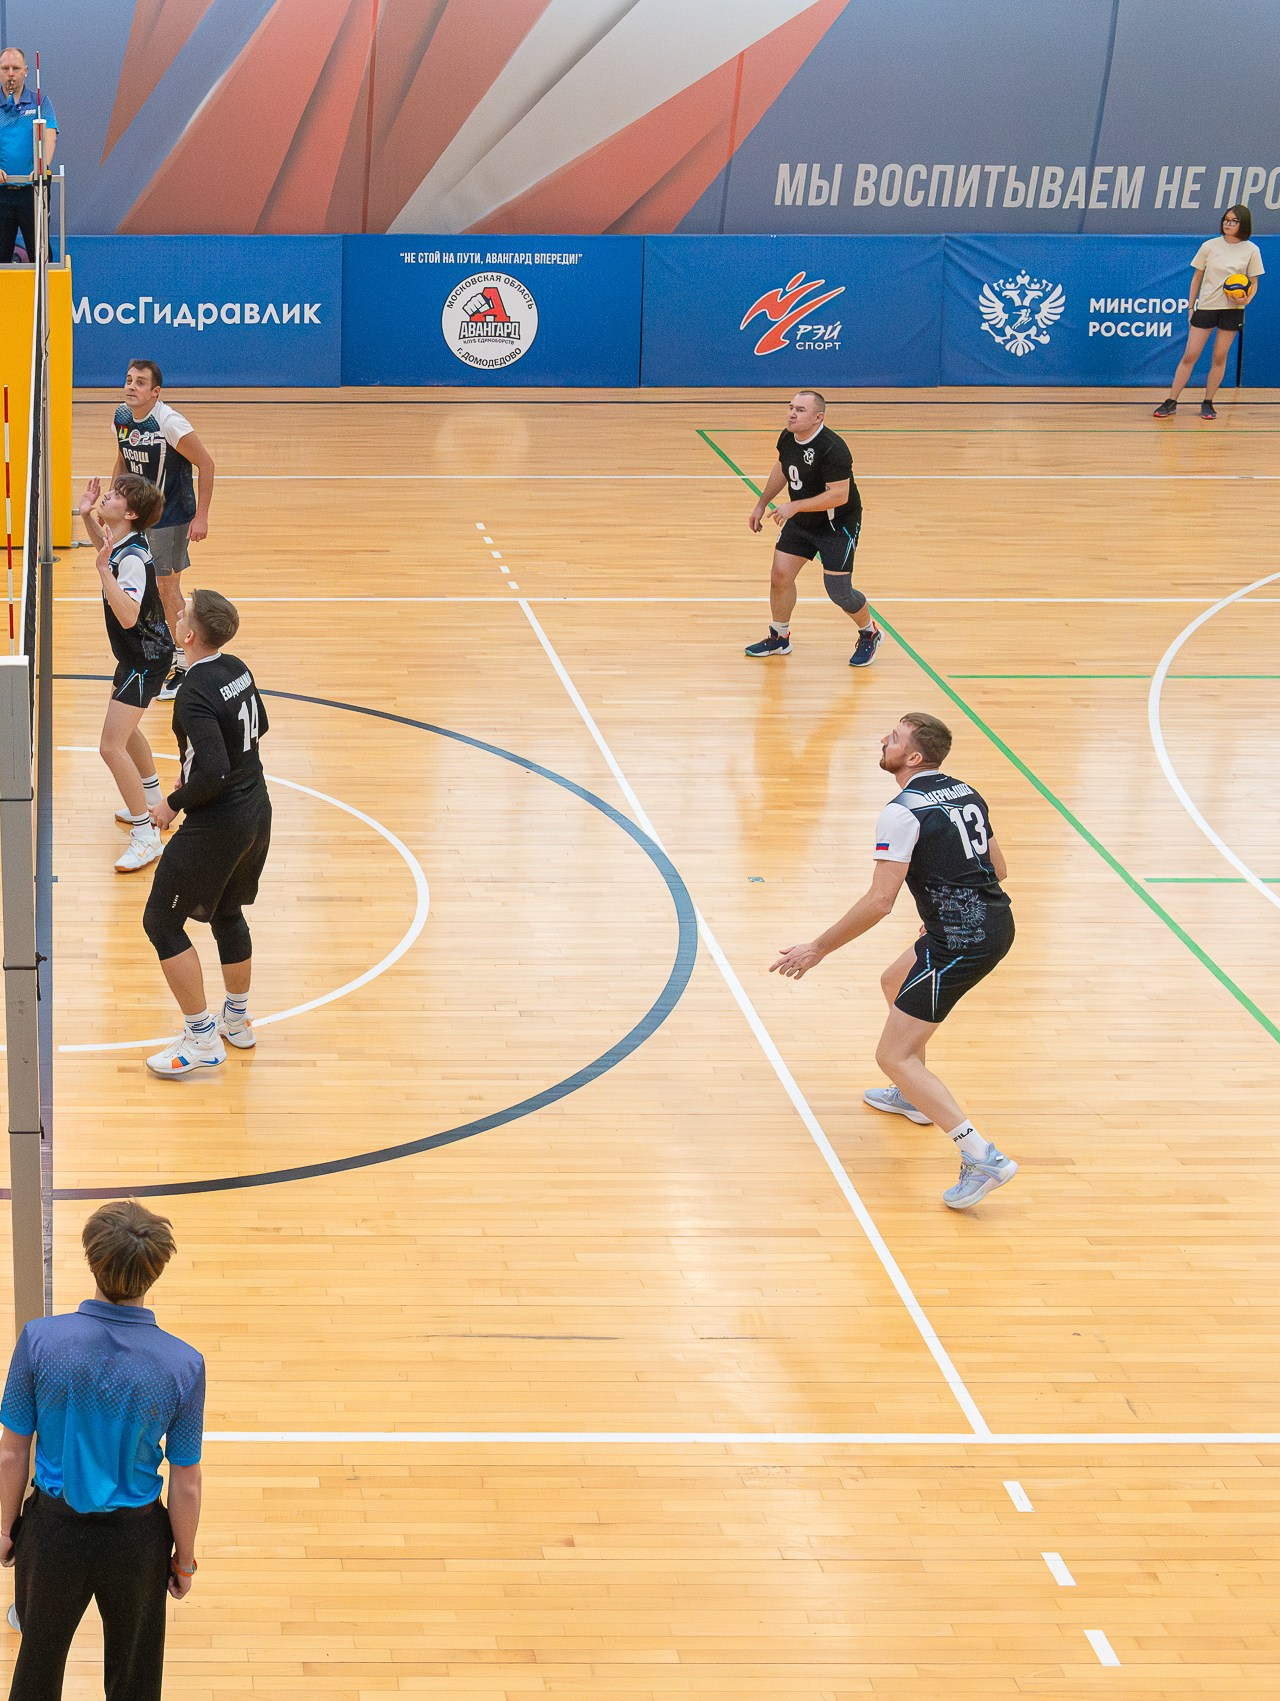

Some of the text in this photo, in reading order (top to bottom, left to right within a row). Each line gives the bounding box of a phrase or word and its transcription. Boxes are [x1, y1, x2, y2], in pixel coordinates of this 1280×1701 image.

[774, 162, 843, 208] МЫ
[851, 163, 1144, 210] ВОСПИТЫВАЕМ
[1153, 165, 1207, 209] НЕ
[418, 250, 440, 264] СТОЙ
[442, 252, 455, 264] НА
[456, 252, 484, 265] ПУТИ,
[485, 252, 533, 266] АВАНГАРД
[446, 274, 535, 310] МОСКОВСКАЯ ОБЛАСТЬ
[72, 296, 322, 331] МосГидравлик
[1089, 298, 1199, 314] МИНСПОР
[459, 321, 521, 340] АВАНГАРД
[796, 321, 842, 341] РЭЙ
[1088, 321, 1173, 337] РОССИИ
[795, 341, 842, 351] СПОРТ
[461, 347, 522, 368] ДОМОДЕДОВО
[788, 464, 803, 491] 9
[237, 693, 259, 753] 14
[949, 803, 988, 860] 13
[952, 1127, 974, 1143] FILA
